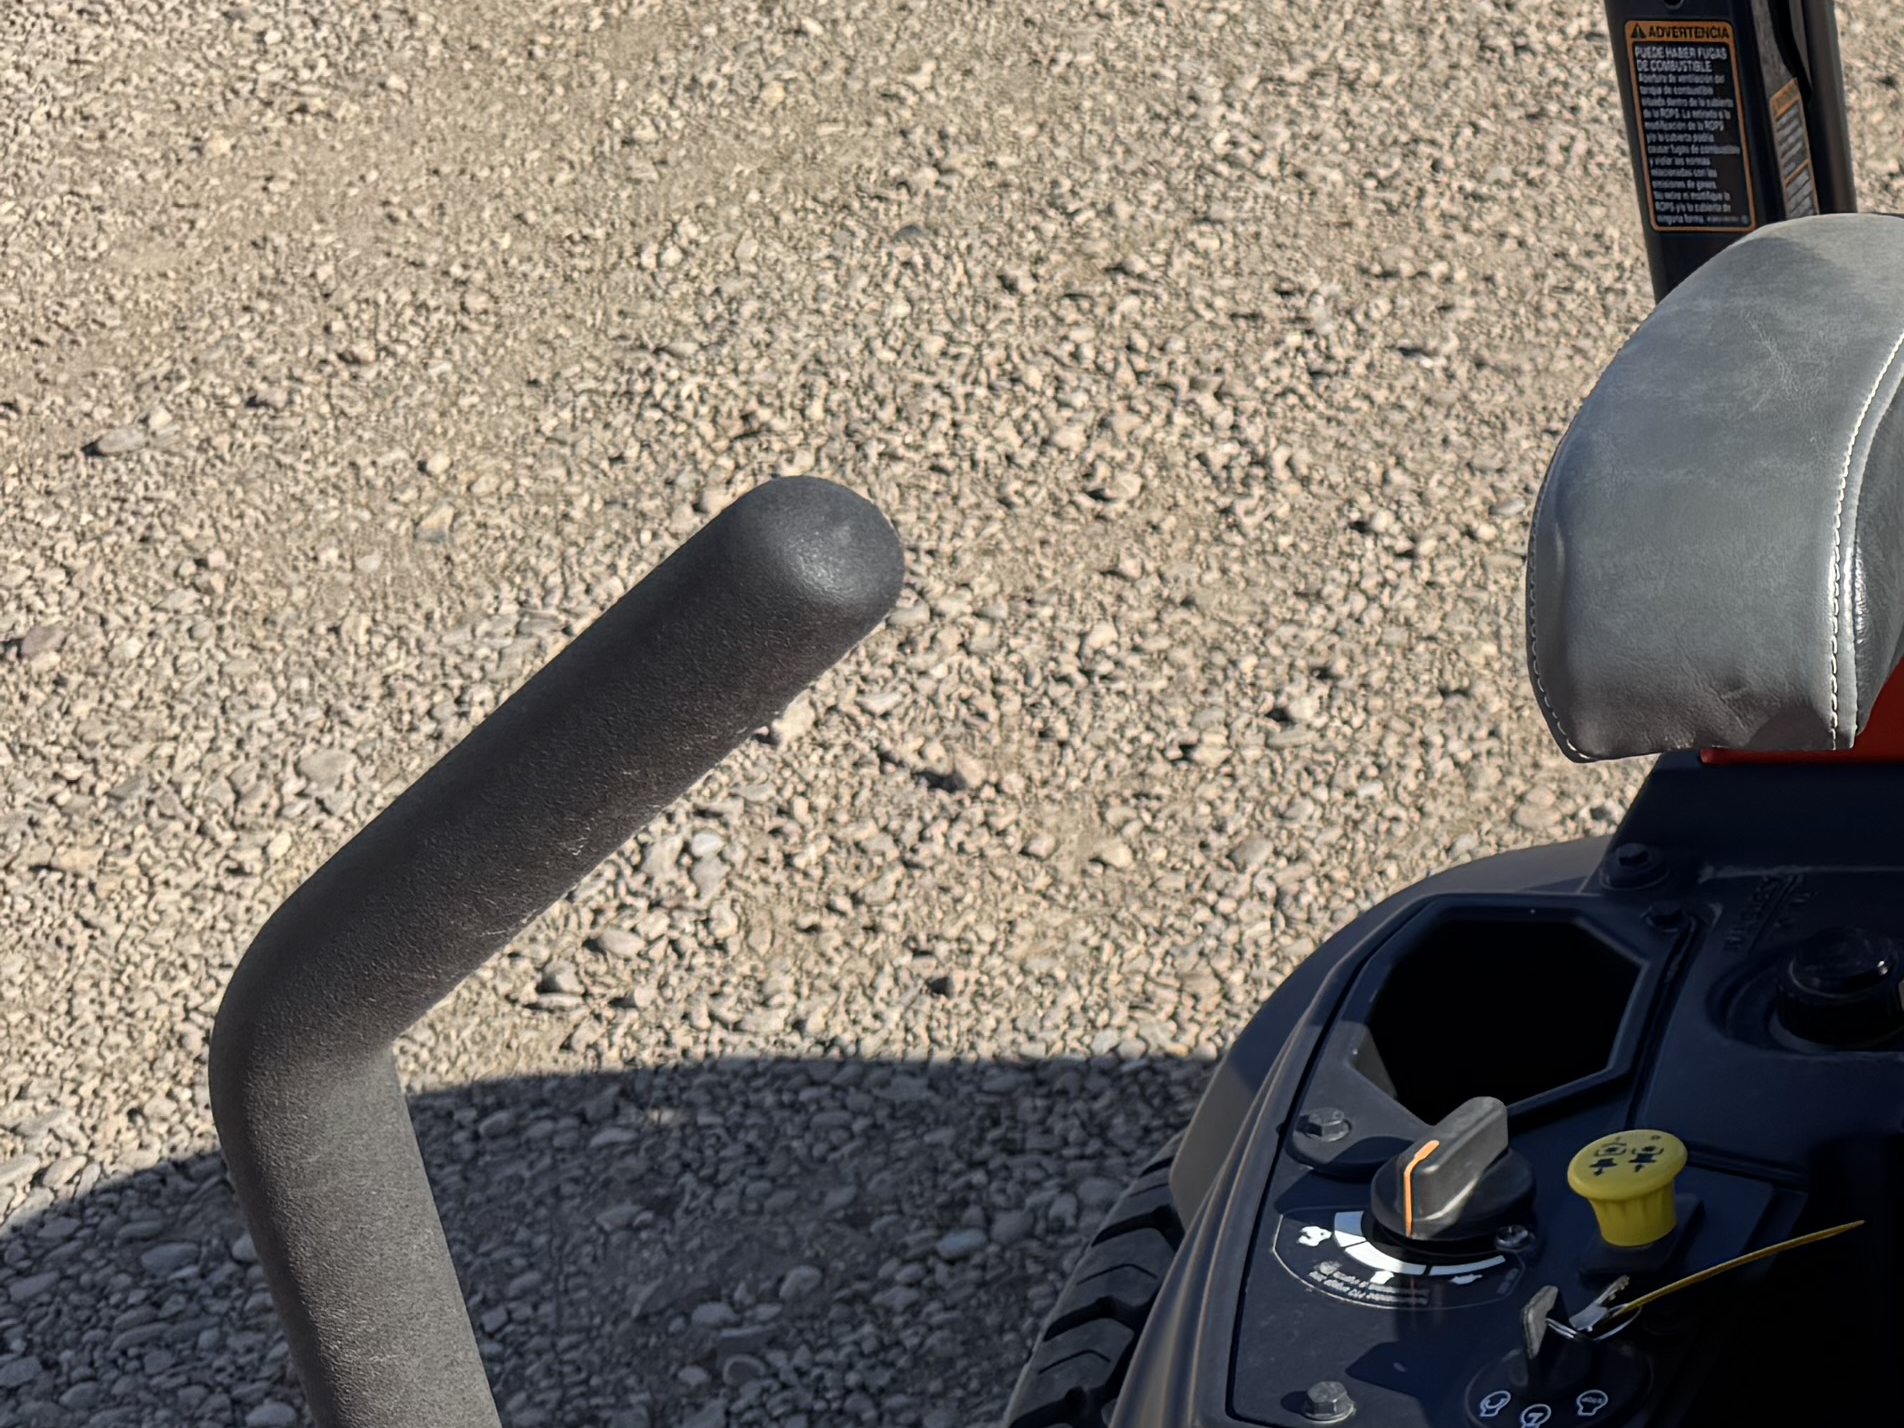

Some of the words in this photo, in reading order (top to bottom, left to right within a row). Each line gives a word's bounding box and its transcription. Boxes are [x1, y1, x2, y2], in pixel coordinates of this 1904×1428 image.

[1649, 26, 1729, 39] ADVERTENCIA
[1635, 45, 1664, 59] PUEDE
[1666, 46, 1695, 59] HABER
[1697, 47, 1728, 60] FUGAS
[1637, 59, 1649, 71] DE
[1650, 60, 1713, 72] COMBUSTIBLE
